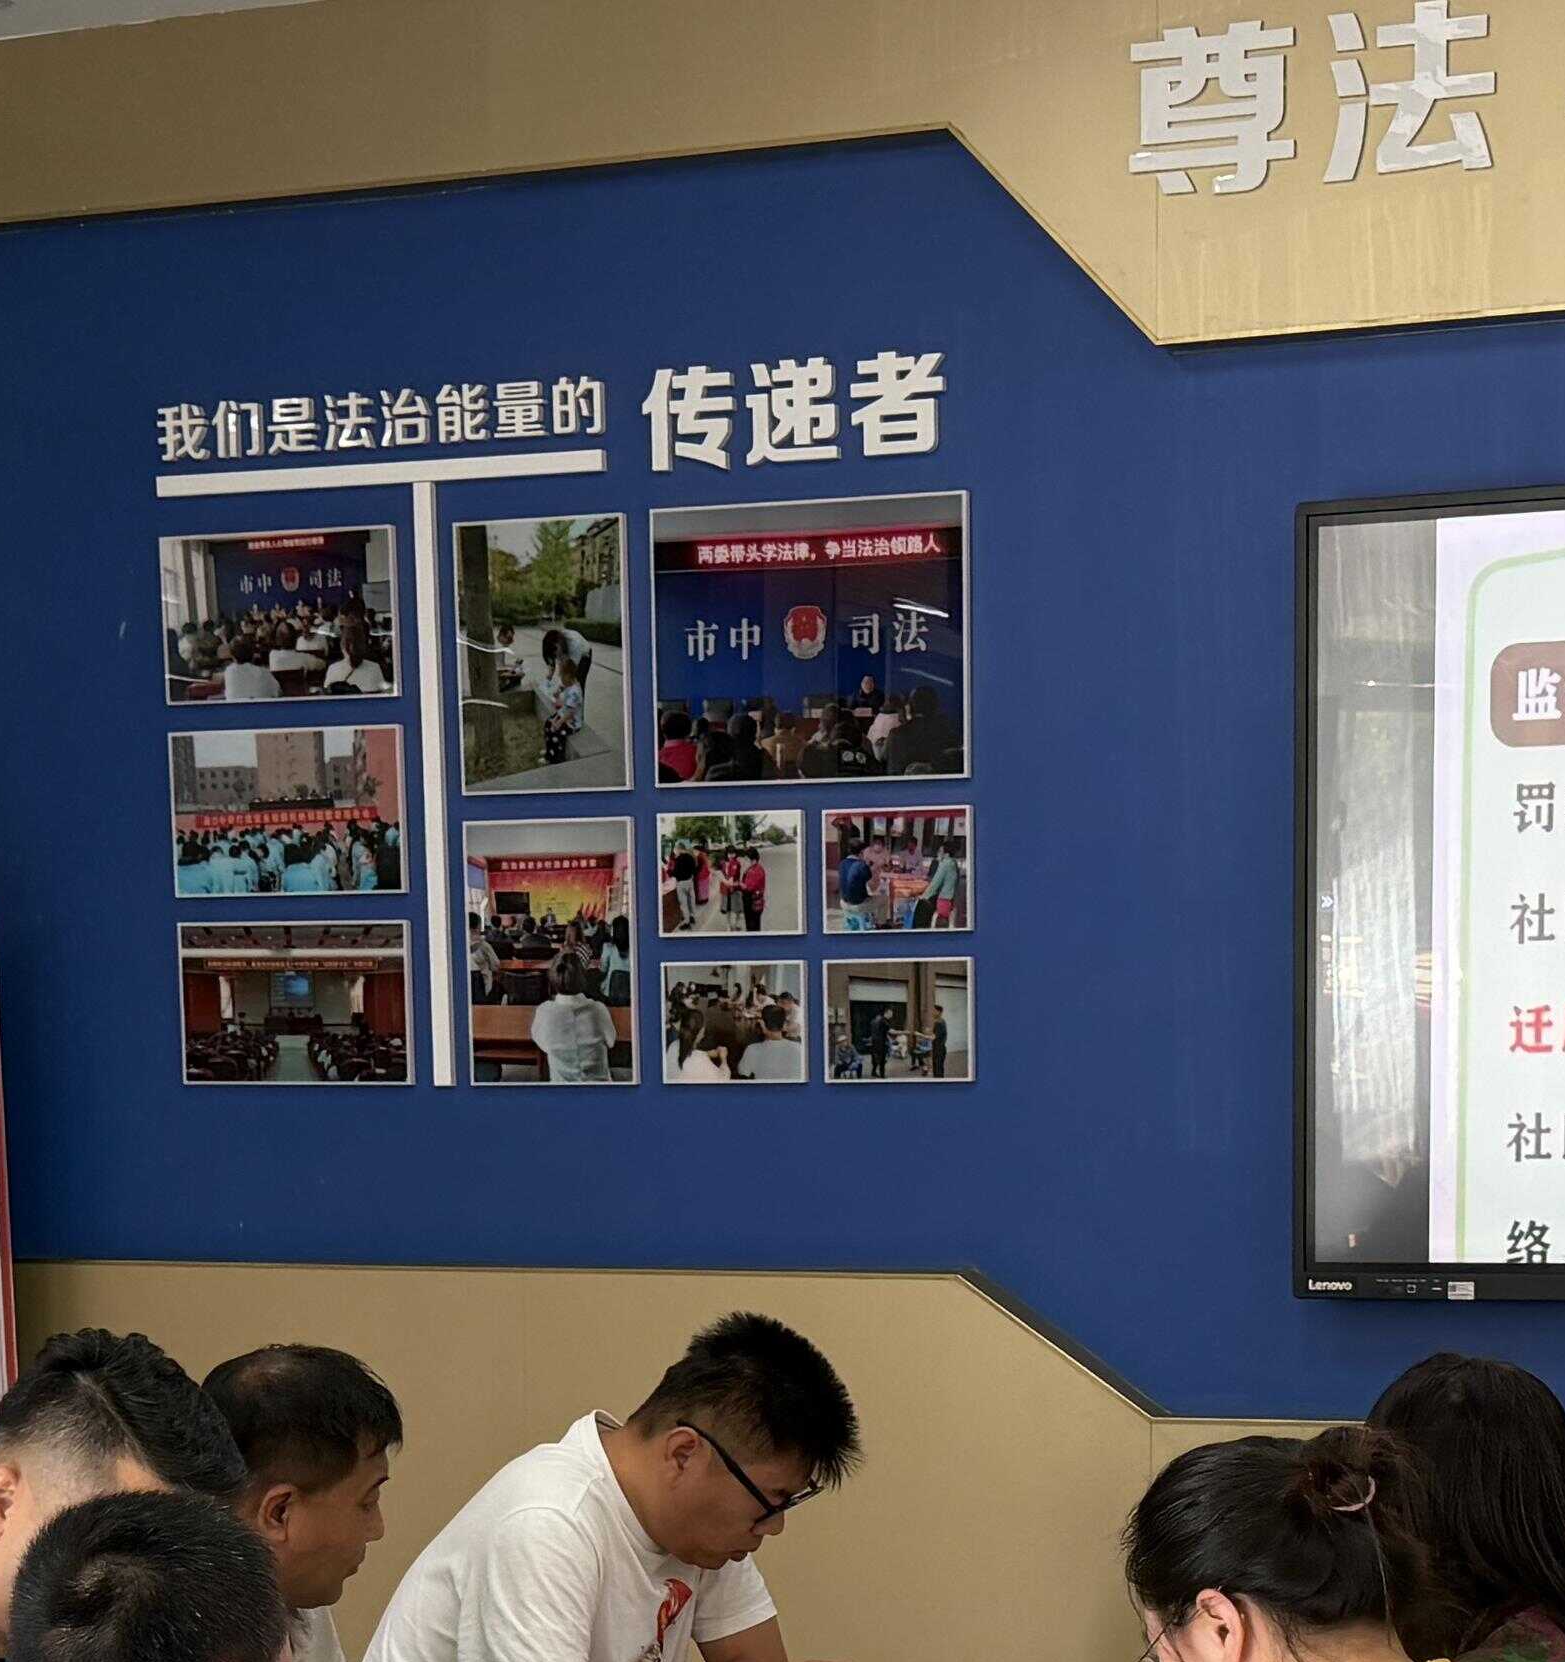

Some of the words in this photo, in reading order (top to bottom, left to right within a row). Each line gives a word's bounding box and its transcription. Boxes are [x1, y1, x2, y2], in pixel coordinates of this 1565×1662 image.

[1128, 0, 1497, 195] 尊法
[155, 375, 607, 463] 我们是法治能量的
[642, 349, 947, 474] 传递者
[685, 617, 761, 662] 市中
[848, 610, 929, 655] 司法
[1308, 1278, 1353, 1291] Lenovo
